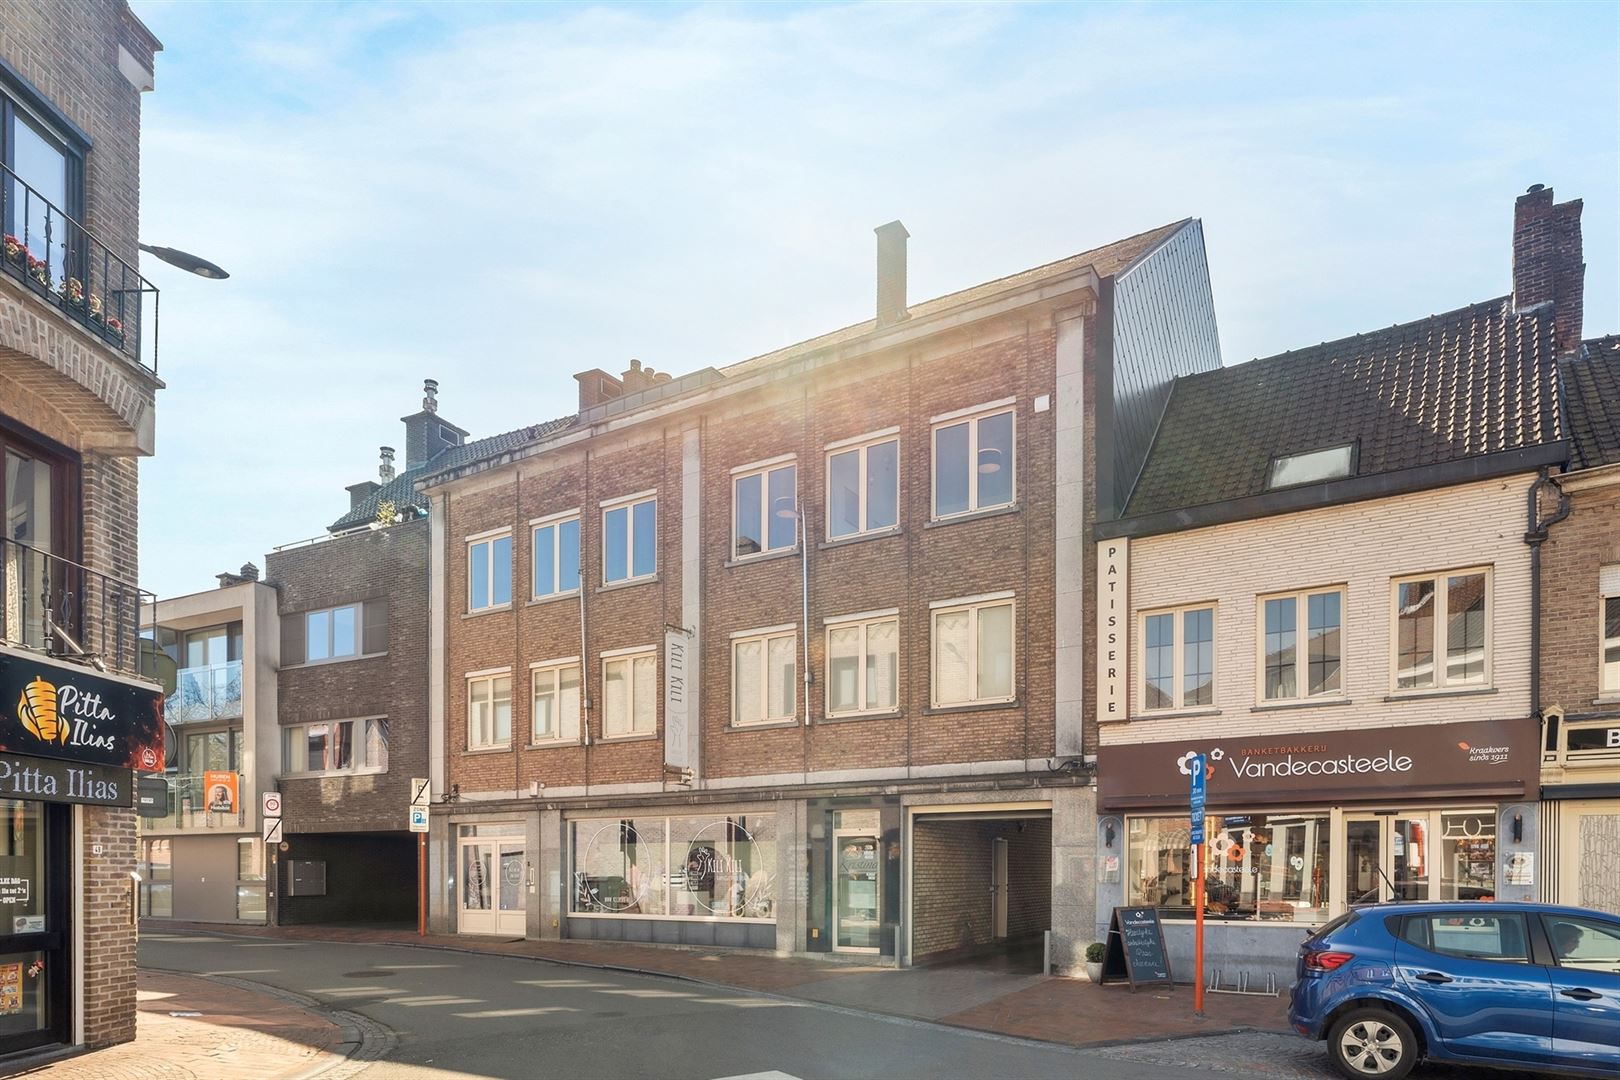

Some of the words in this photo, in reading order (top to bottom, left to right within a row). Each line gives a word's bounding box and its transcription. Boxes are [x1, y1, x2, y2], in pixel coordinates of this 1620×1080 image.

[1108, 547, 1117, 713] PATISSERIE
[670, 642, 685, 671] KILI
[57, 685, 116, 721] Pitta
[670, 675, 685, 704] KILI
[69, 718, 116, 750] Ilias
[1229, 749, 1413, 779] Vandecasteele
[1469, 753, 1489, 761] sinds
[1490, 754, 1508, 762] 1911
[66, 768, 118, 800] Ilias
[707, 858, 724, 873] KILI
[726, 858, 742, 873] KILI
